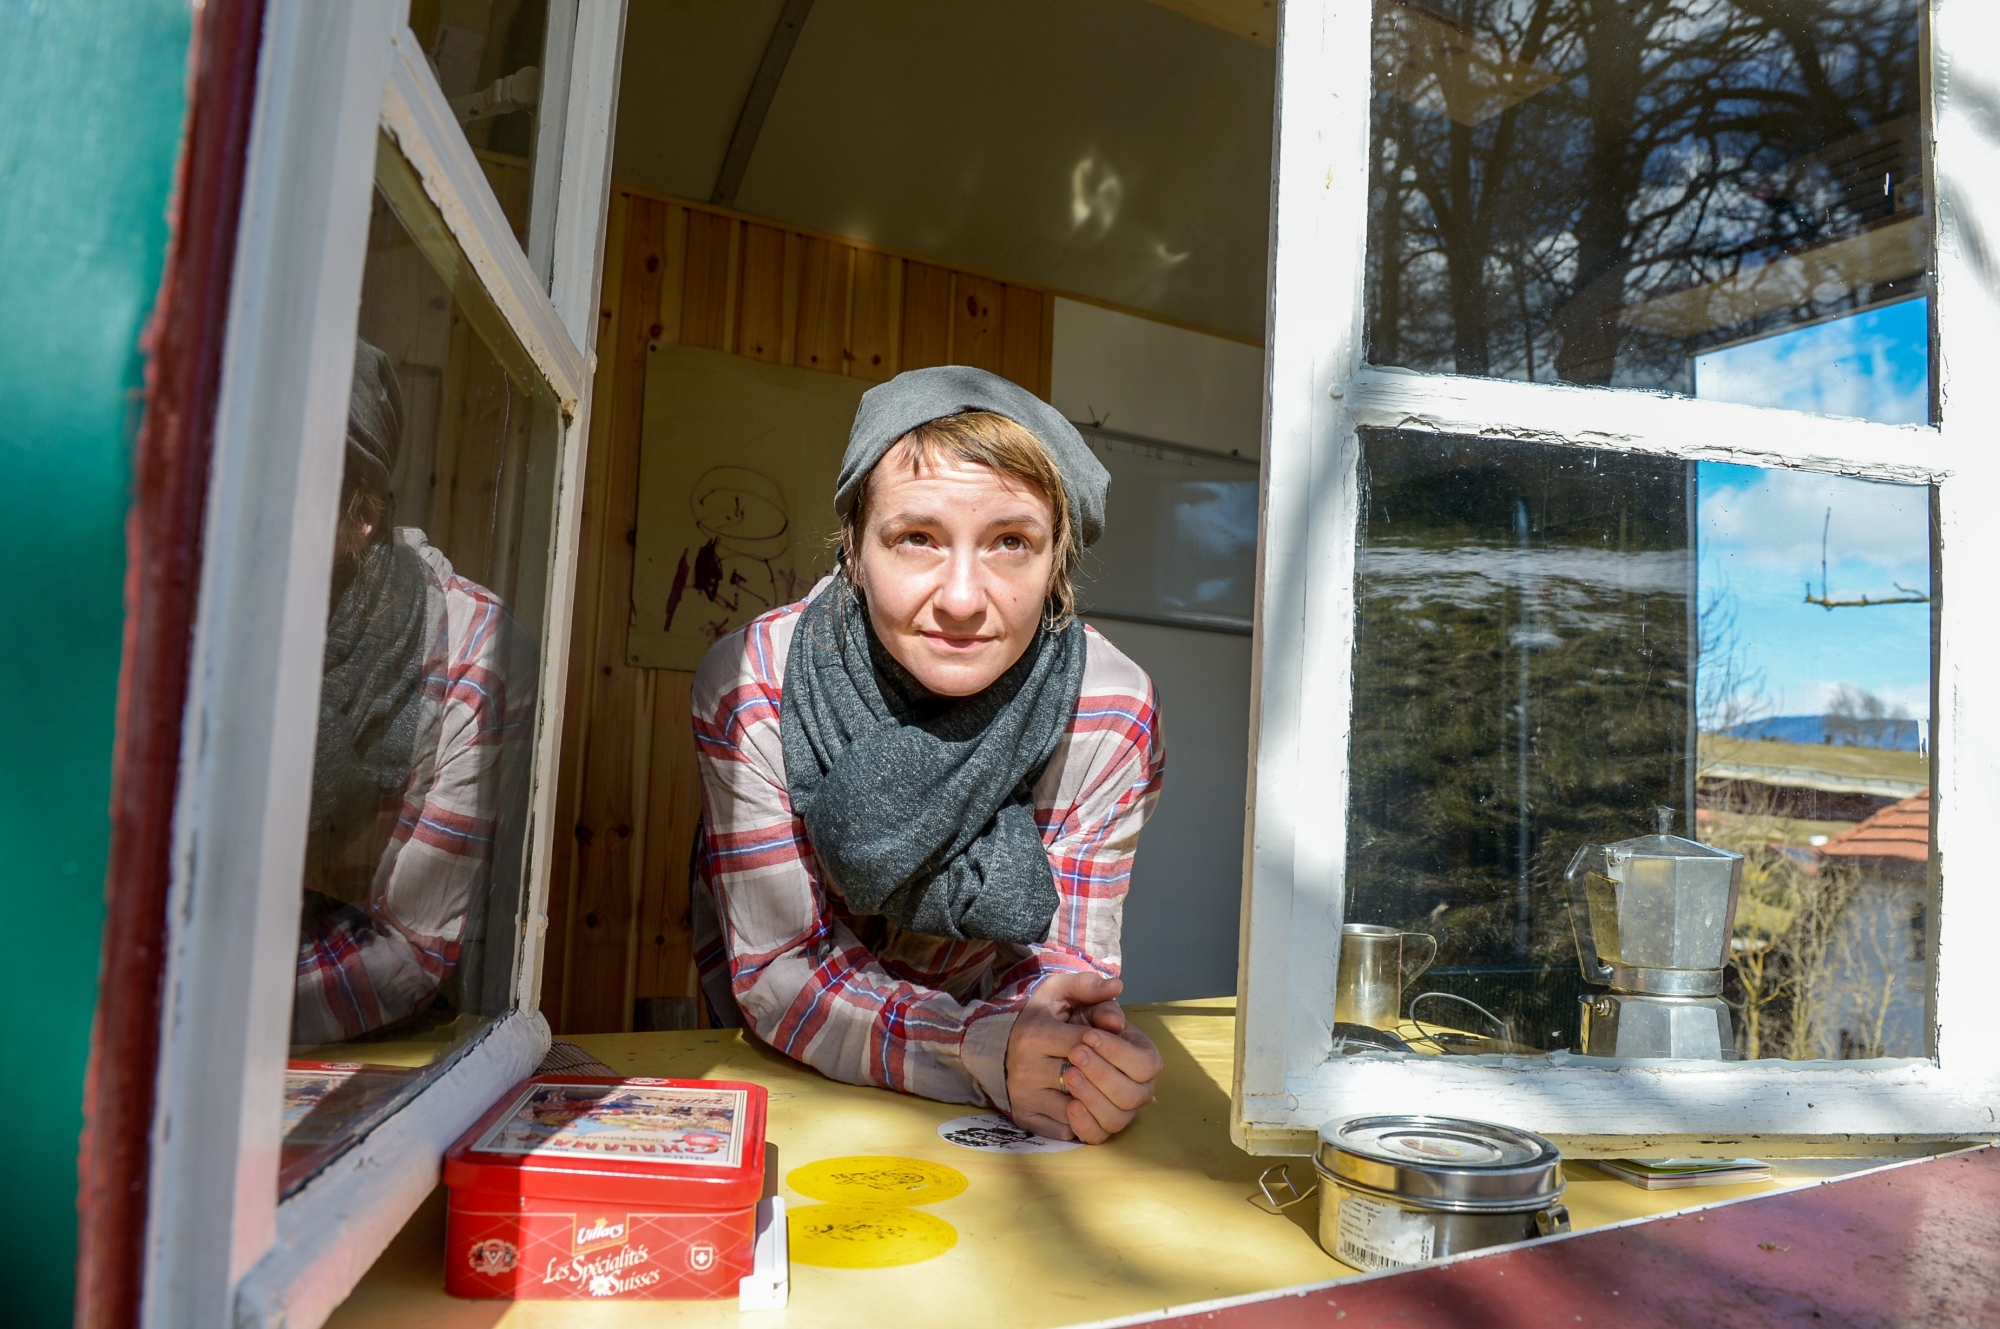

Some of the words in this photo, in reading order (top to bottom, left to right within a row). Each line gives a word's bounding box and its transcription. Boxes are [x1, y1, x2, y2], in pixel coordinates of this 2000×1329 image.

[577, 1223, 624, 1245] Villars
[542, 1257, 569, 1284] Les
[569, 1244, 649, 1290] Spécialités
[606, 1268, 660, 1296] Suisses
